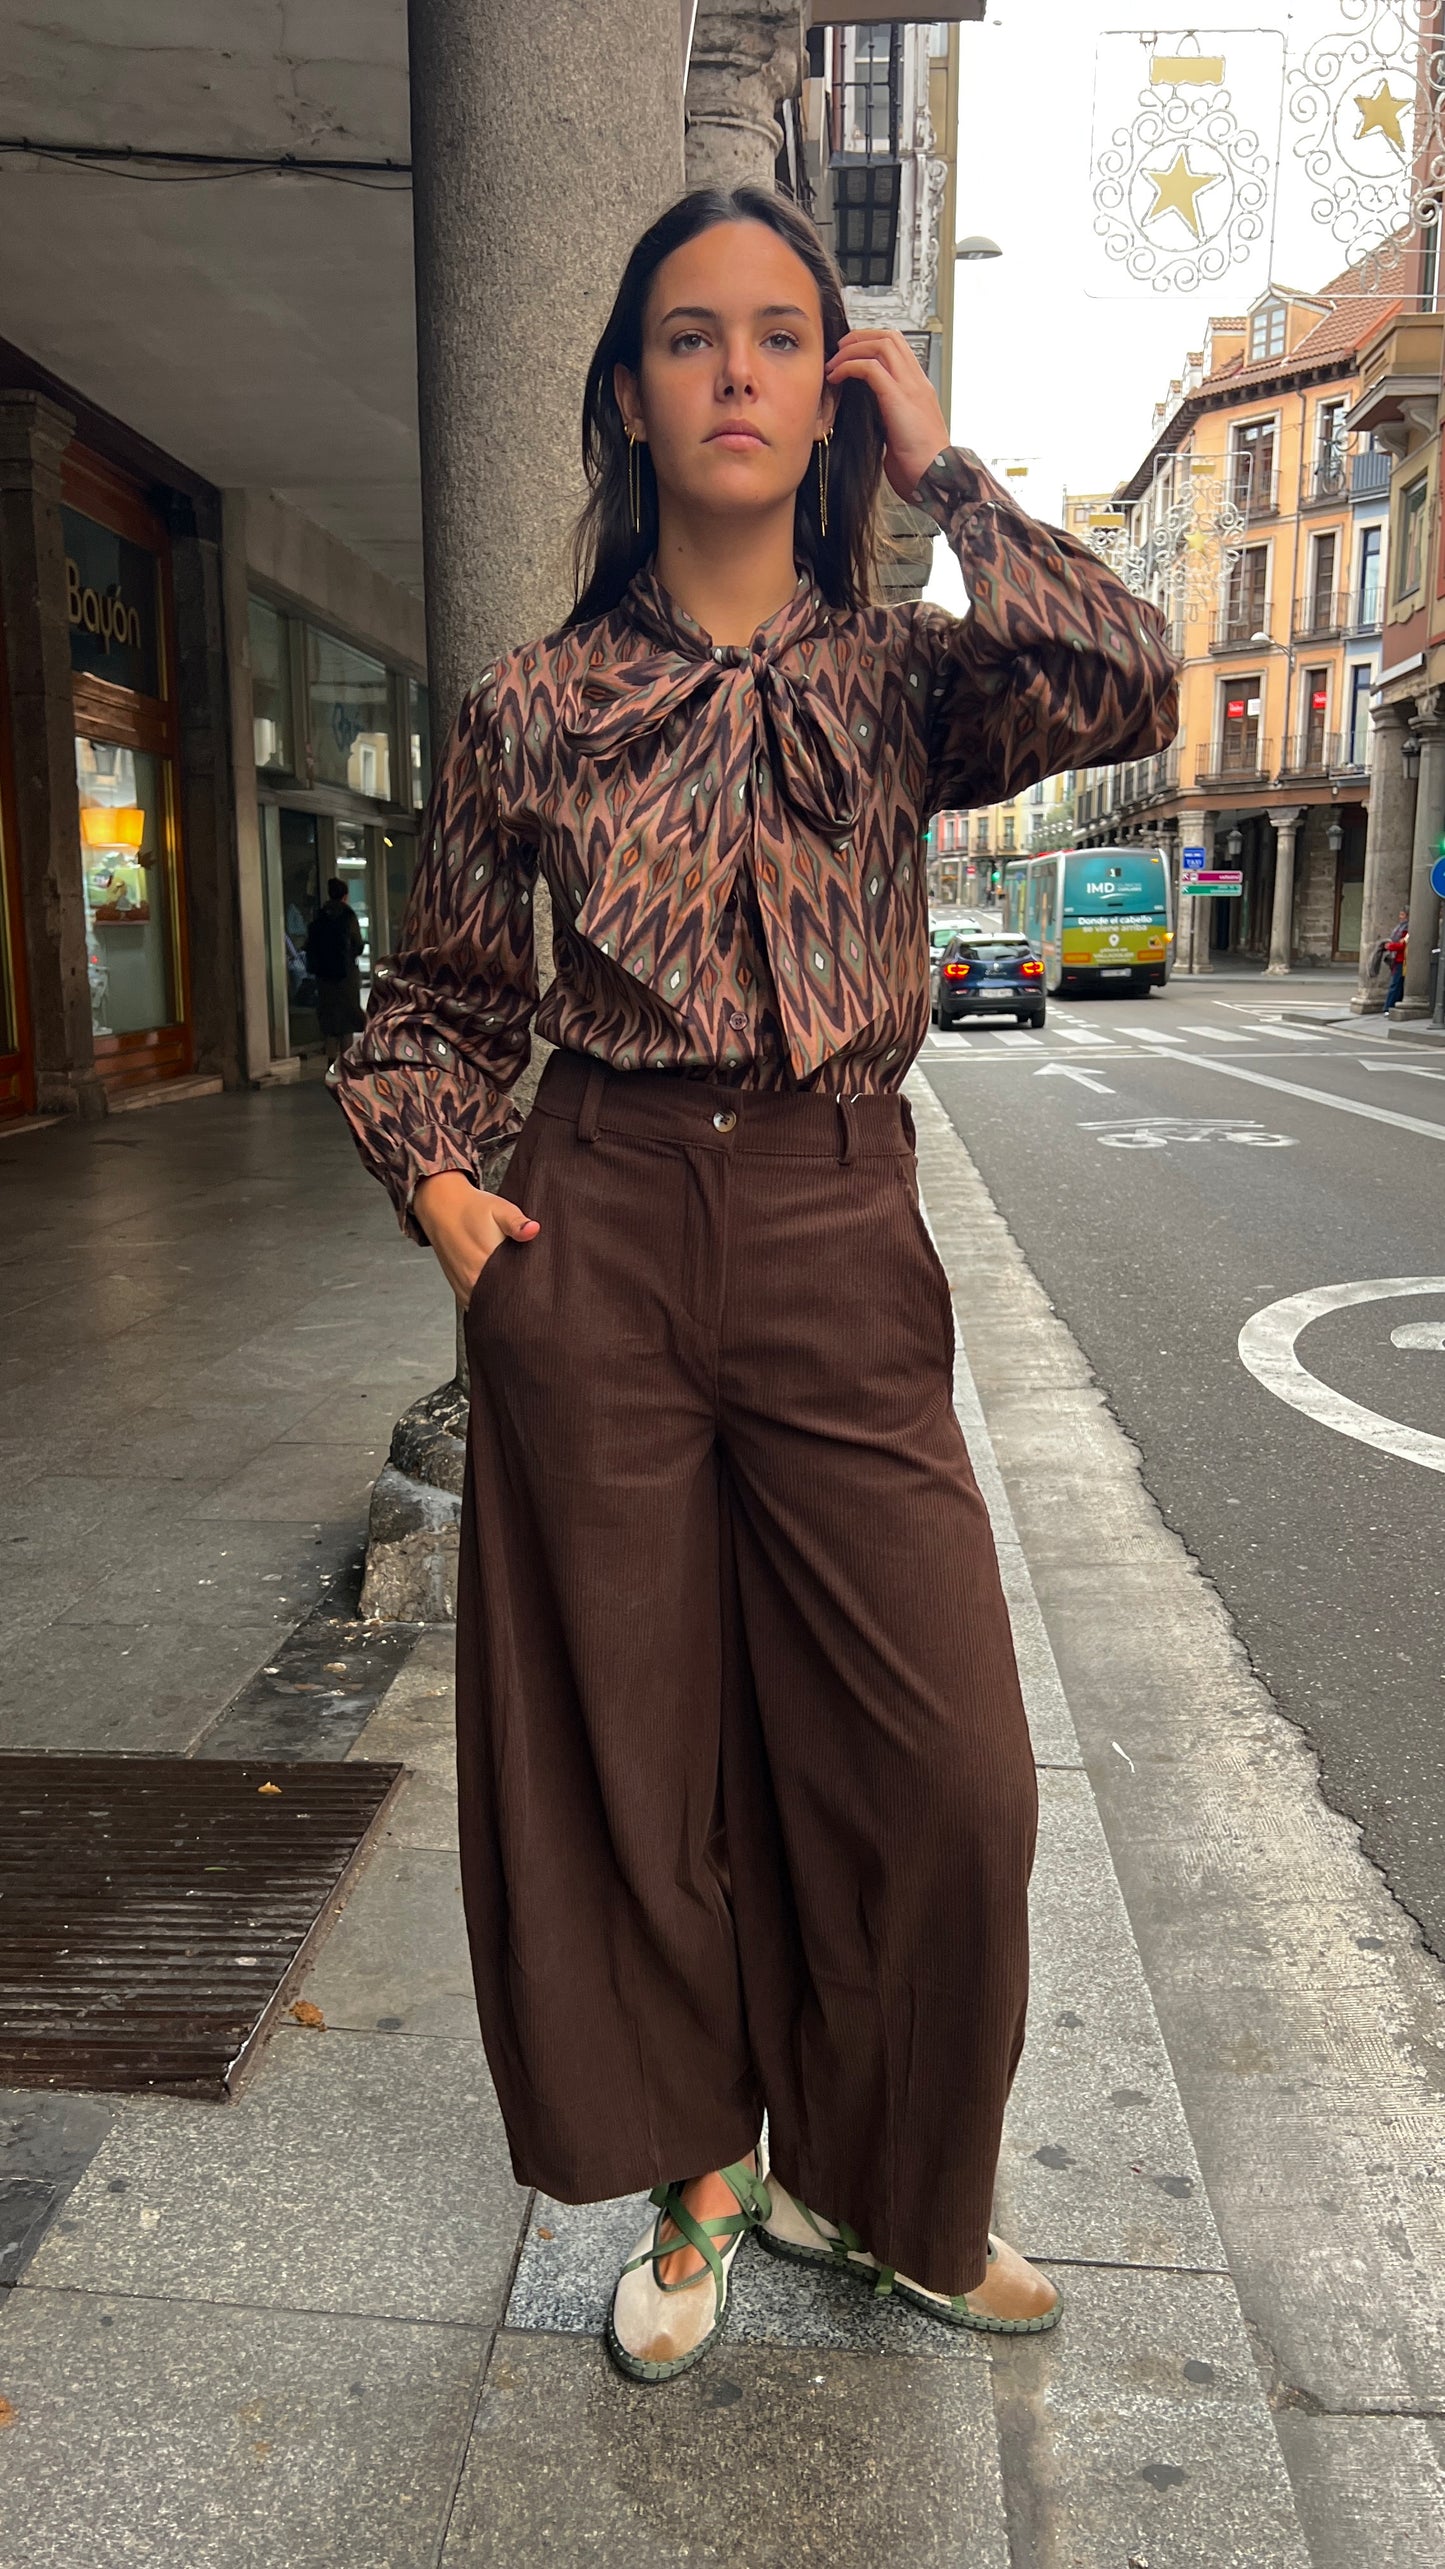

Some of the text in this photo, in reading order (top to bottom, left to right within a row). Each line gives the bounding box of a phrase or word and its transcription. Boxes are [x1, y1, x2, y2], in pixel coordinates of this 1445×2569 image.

[65, 557, 141, 655] Bayón
[1086, 882, 1115, 894] IMD
[1078, 915, 1153, 925] Donde el cabello
[1121, 924, 1148, 932] arriba
